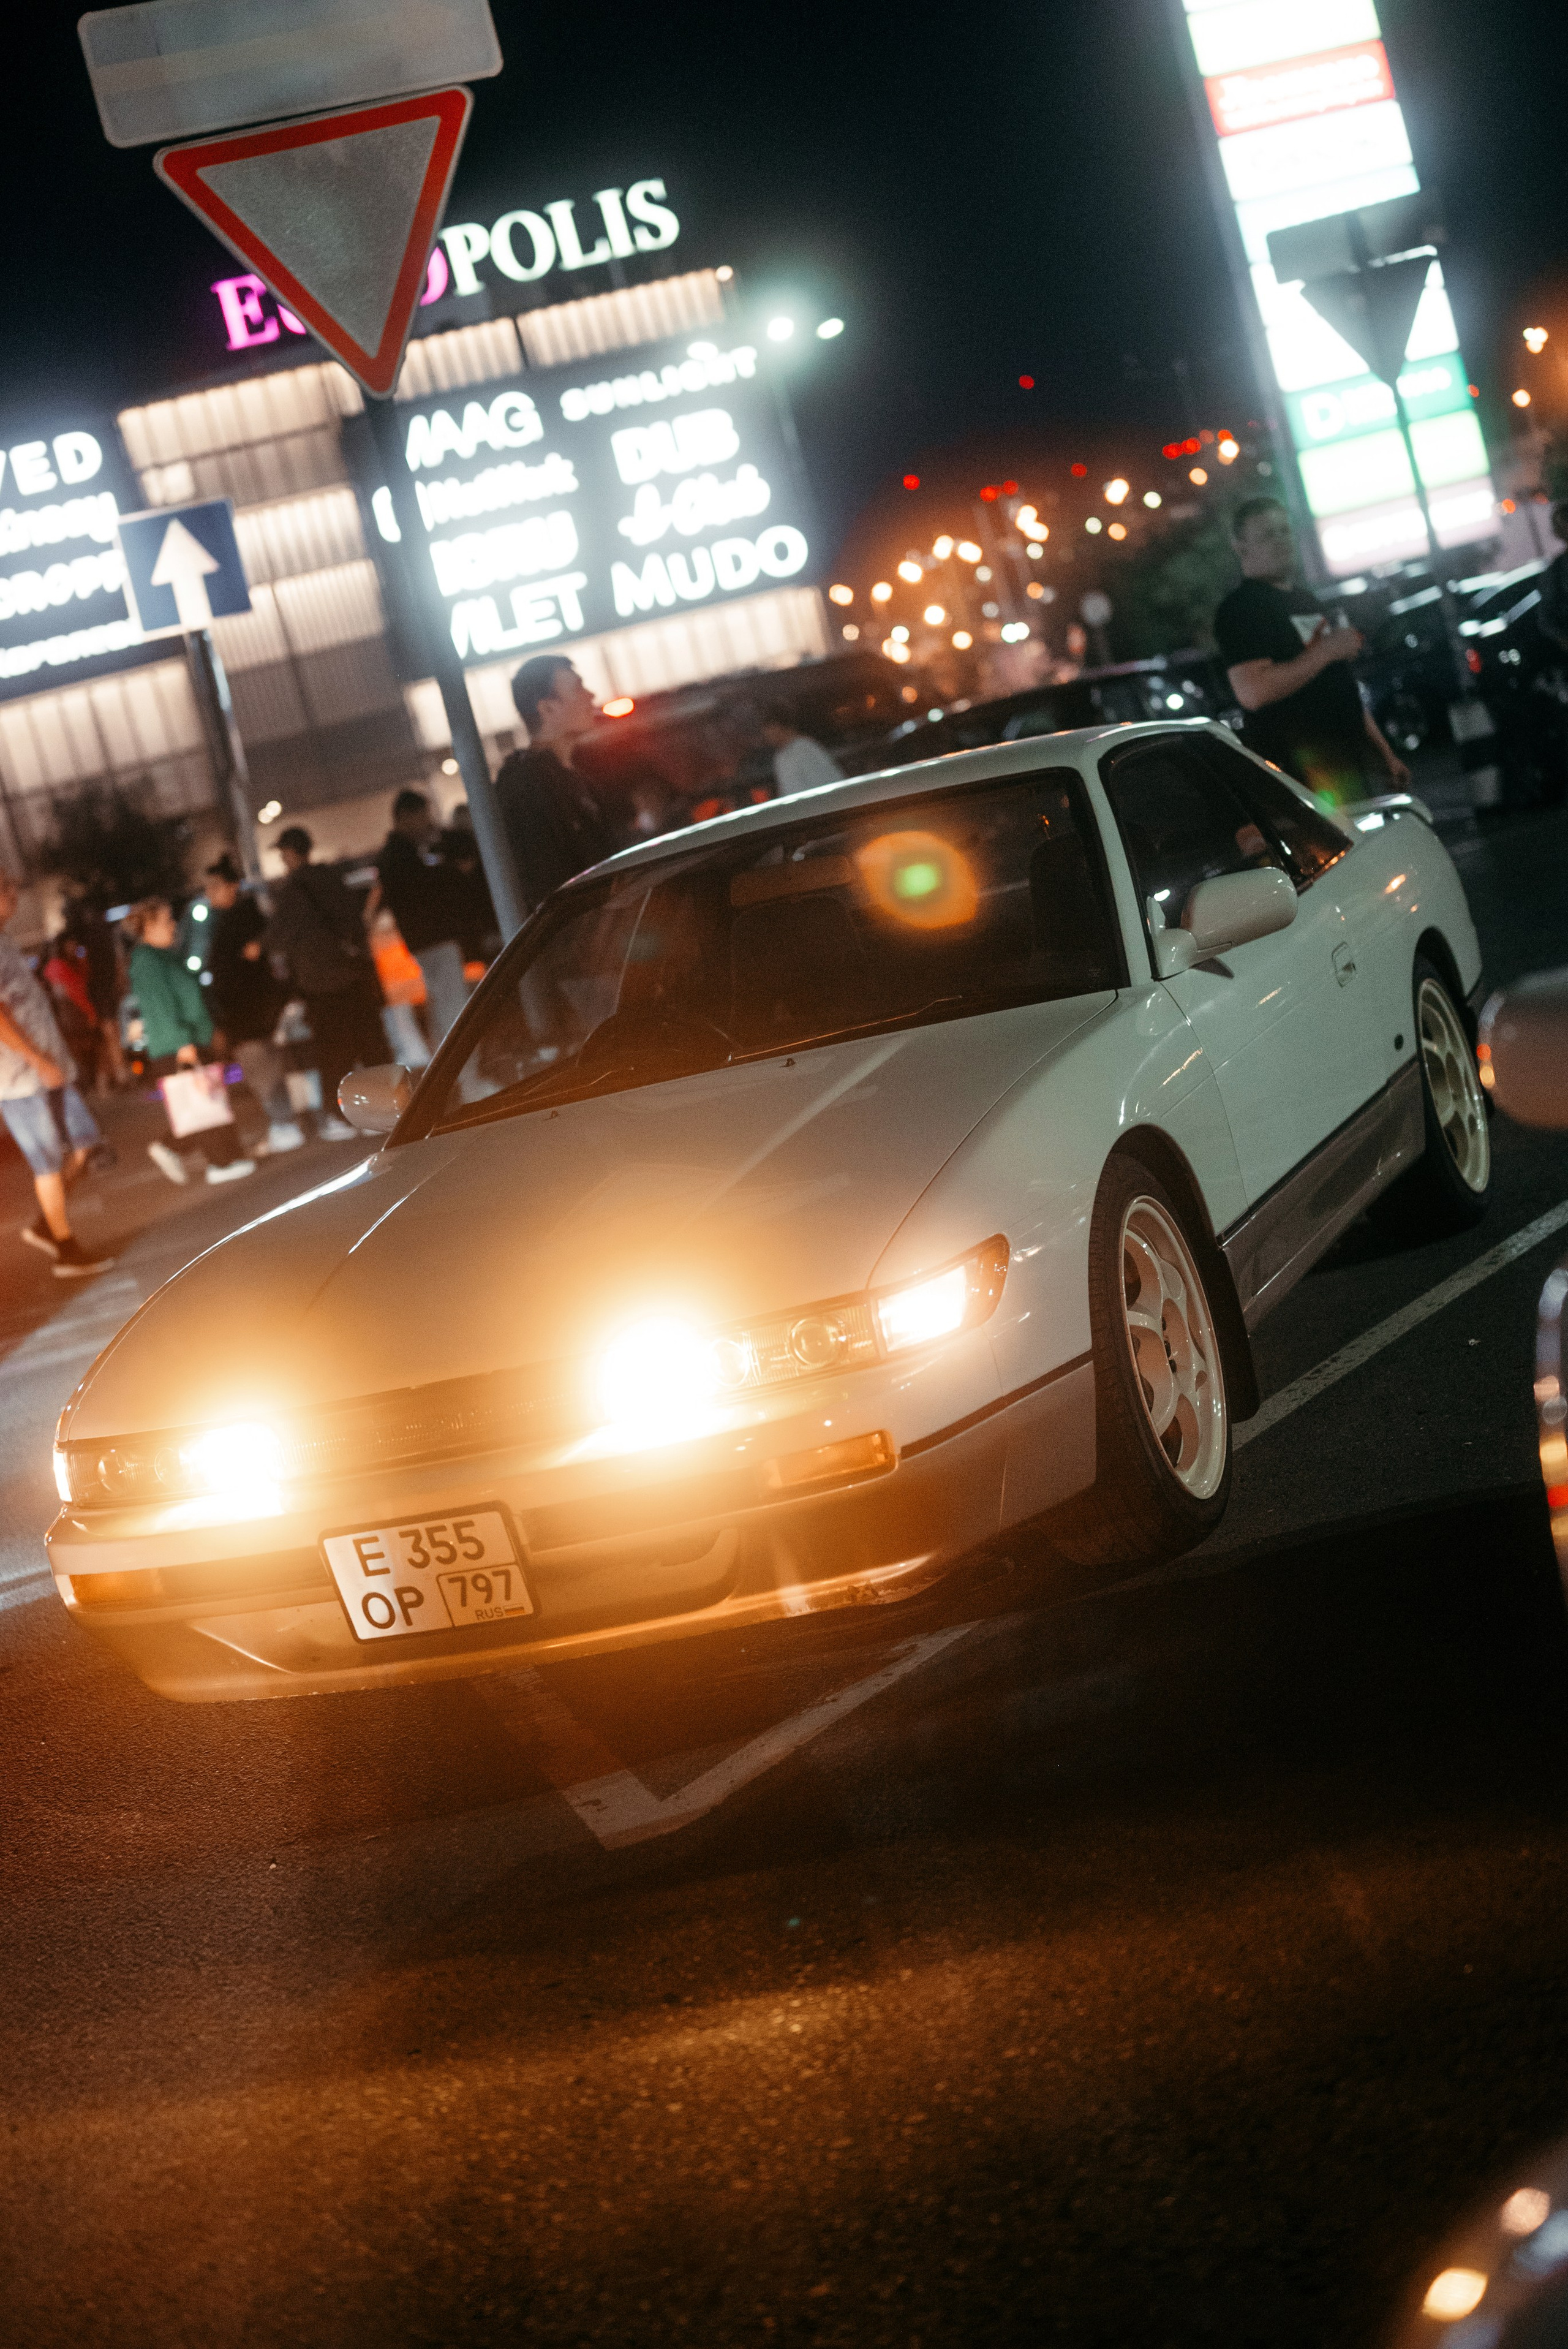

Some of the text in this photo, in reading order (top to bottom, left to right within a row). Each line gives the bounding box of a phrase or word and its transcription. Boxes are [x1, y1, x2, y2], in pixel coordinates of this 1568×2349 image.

[211, 178, 680, 352] EPOLIS
[0, 431, 103, 497] ED
[610, 408, 741, 485] DUB
[611, 524, 809, 617] MUDO
[353, 1520, 486, 1577] E 355
[361, 1569, 513, 1630] OP 797
[475, 1606, 503, 1621] RUS
